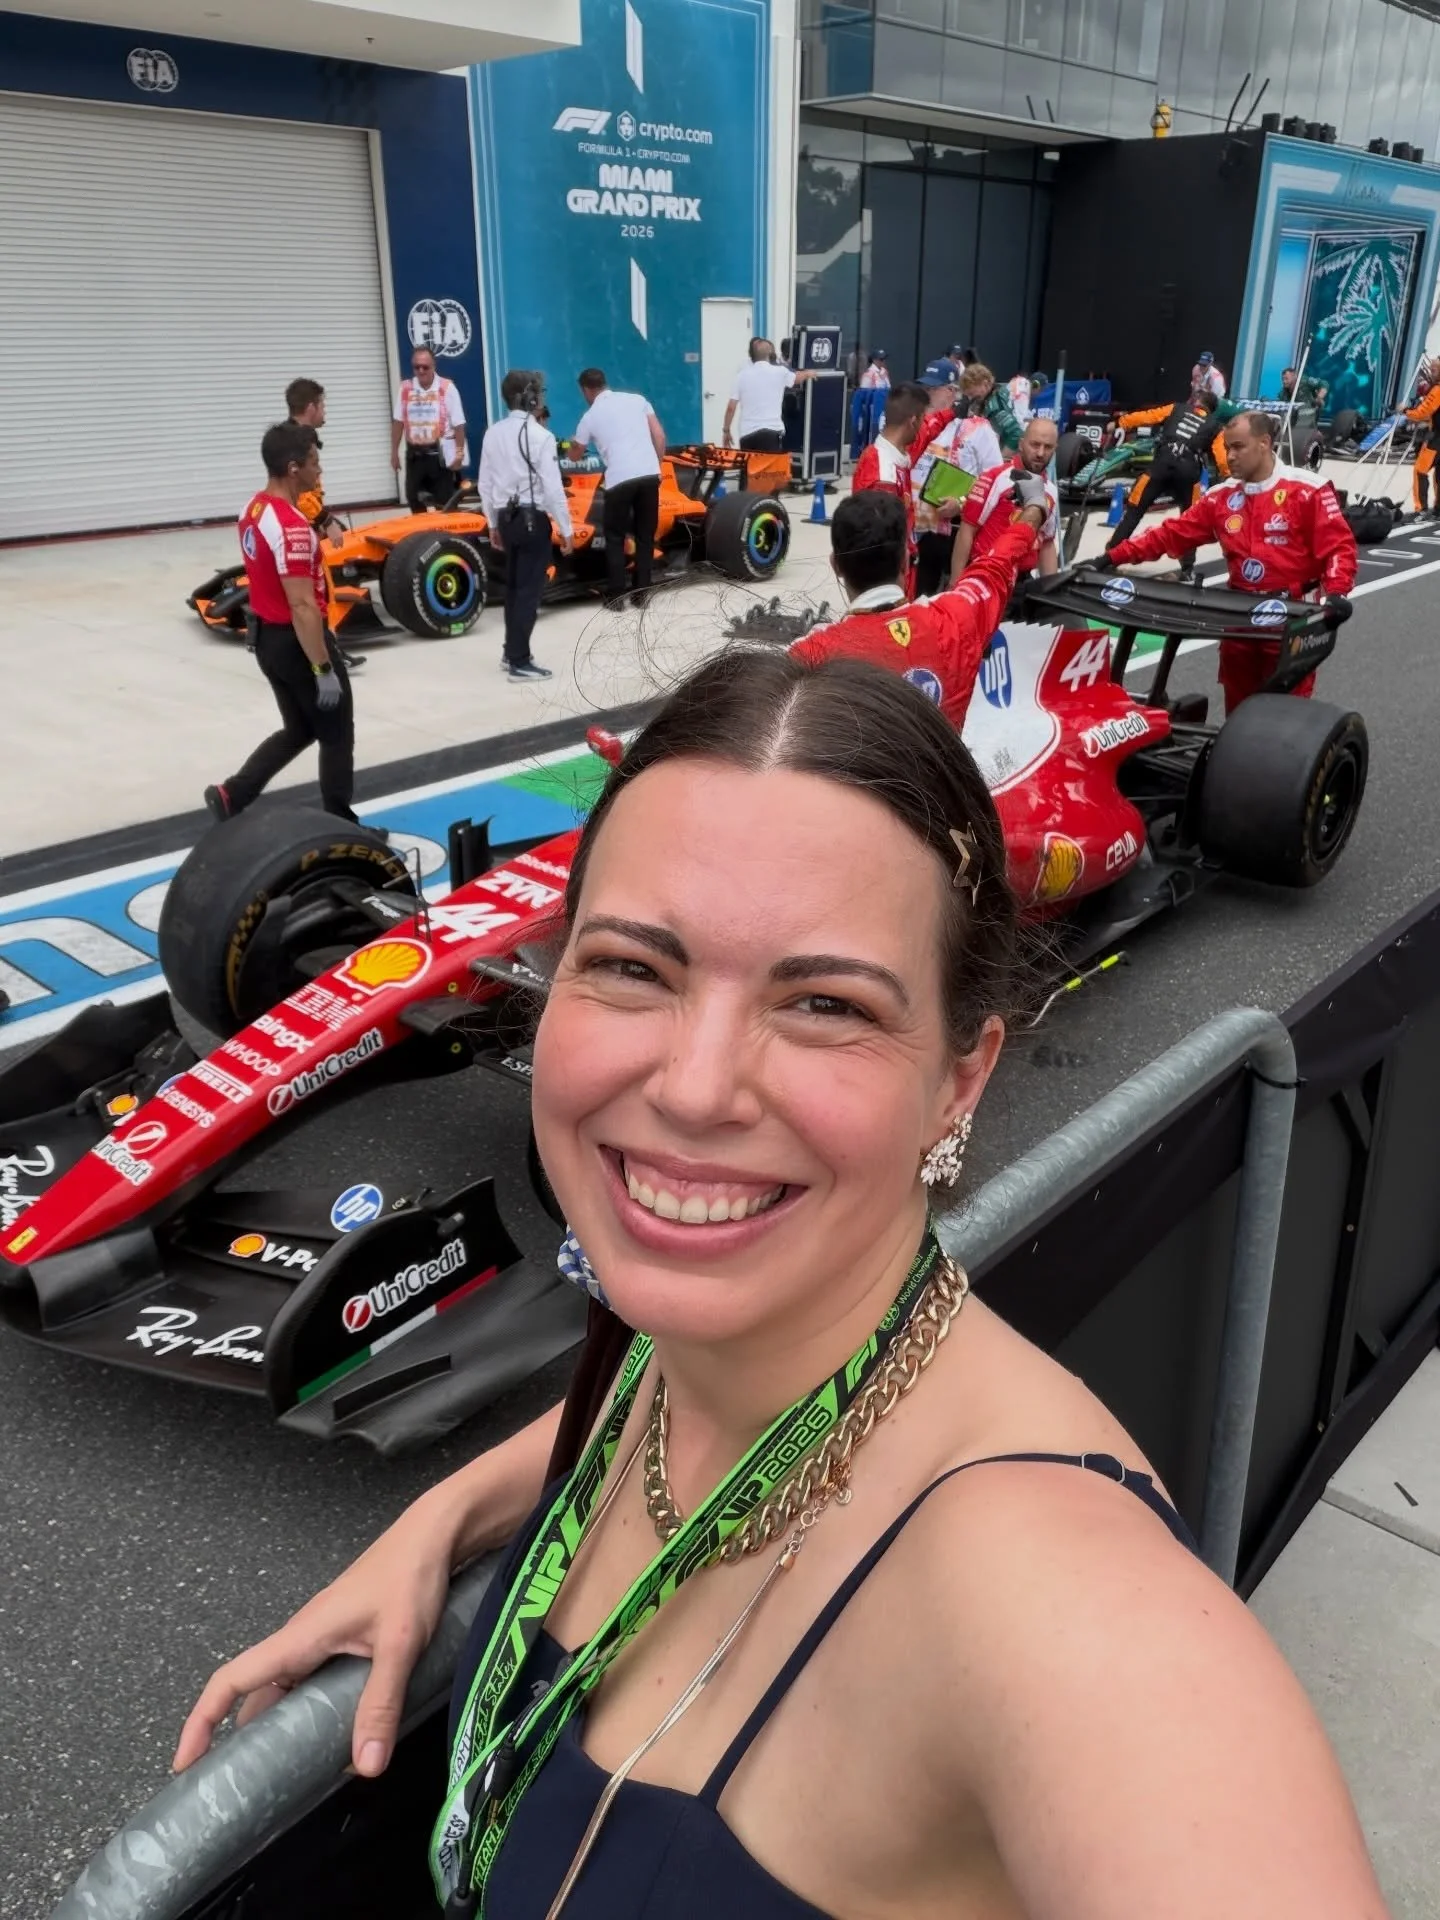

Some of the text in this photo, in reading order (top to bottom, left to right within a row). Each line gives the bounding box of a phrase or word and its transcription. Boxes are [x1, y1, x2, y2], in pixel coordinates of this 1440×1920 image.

[639, 122, 713, 144] crypto.com
[578, 143, 622, 156] FORMULA
[637, 148, 690, 163] CRYPTO.COM
[599, 164, 673, 193] MIAMI
[567, 188, 702, 221] GRAND PRIX
[621, 225, 655, 239] 2026
[1243, 559, 1264, 583] hp
[1059, 635, 1108, 692] 44
[1096, 711, 1149, 749] UniCredit
[327, 843, 405, 879] ZERO
[474, 869, 562, 910] ZYN
[418, 902, 520, 943] 44
[282, 982, 364, 1032] IBM
[220, 1039, 282, 1077] WHOOP
[291, 1027, 383, 1100] UniCredit
[164, 1090, 216, 1128] GENESYS
[332, 1184, 382, 1232] hp
[368, 1238, 467, 1316] UniCredit
[897, 1281, 917, 1306] World
[719, 1402, 834, 1521] VIP 2026
[516, 1541, 567, 1619] VIP
[473, 1821, 503, 1889] MIAMI
